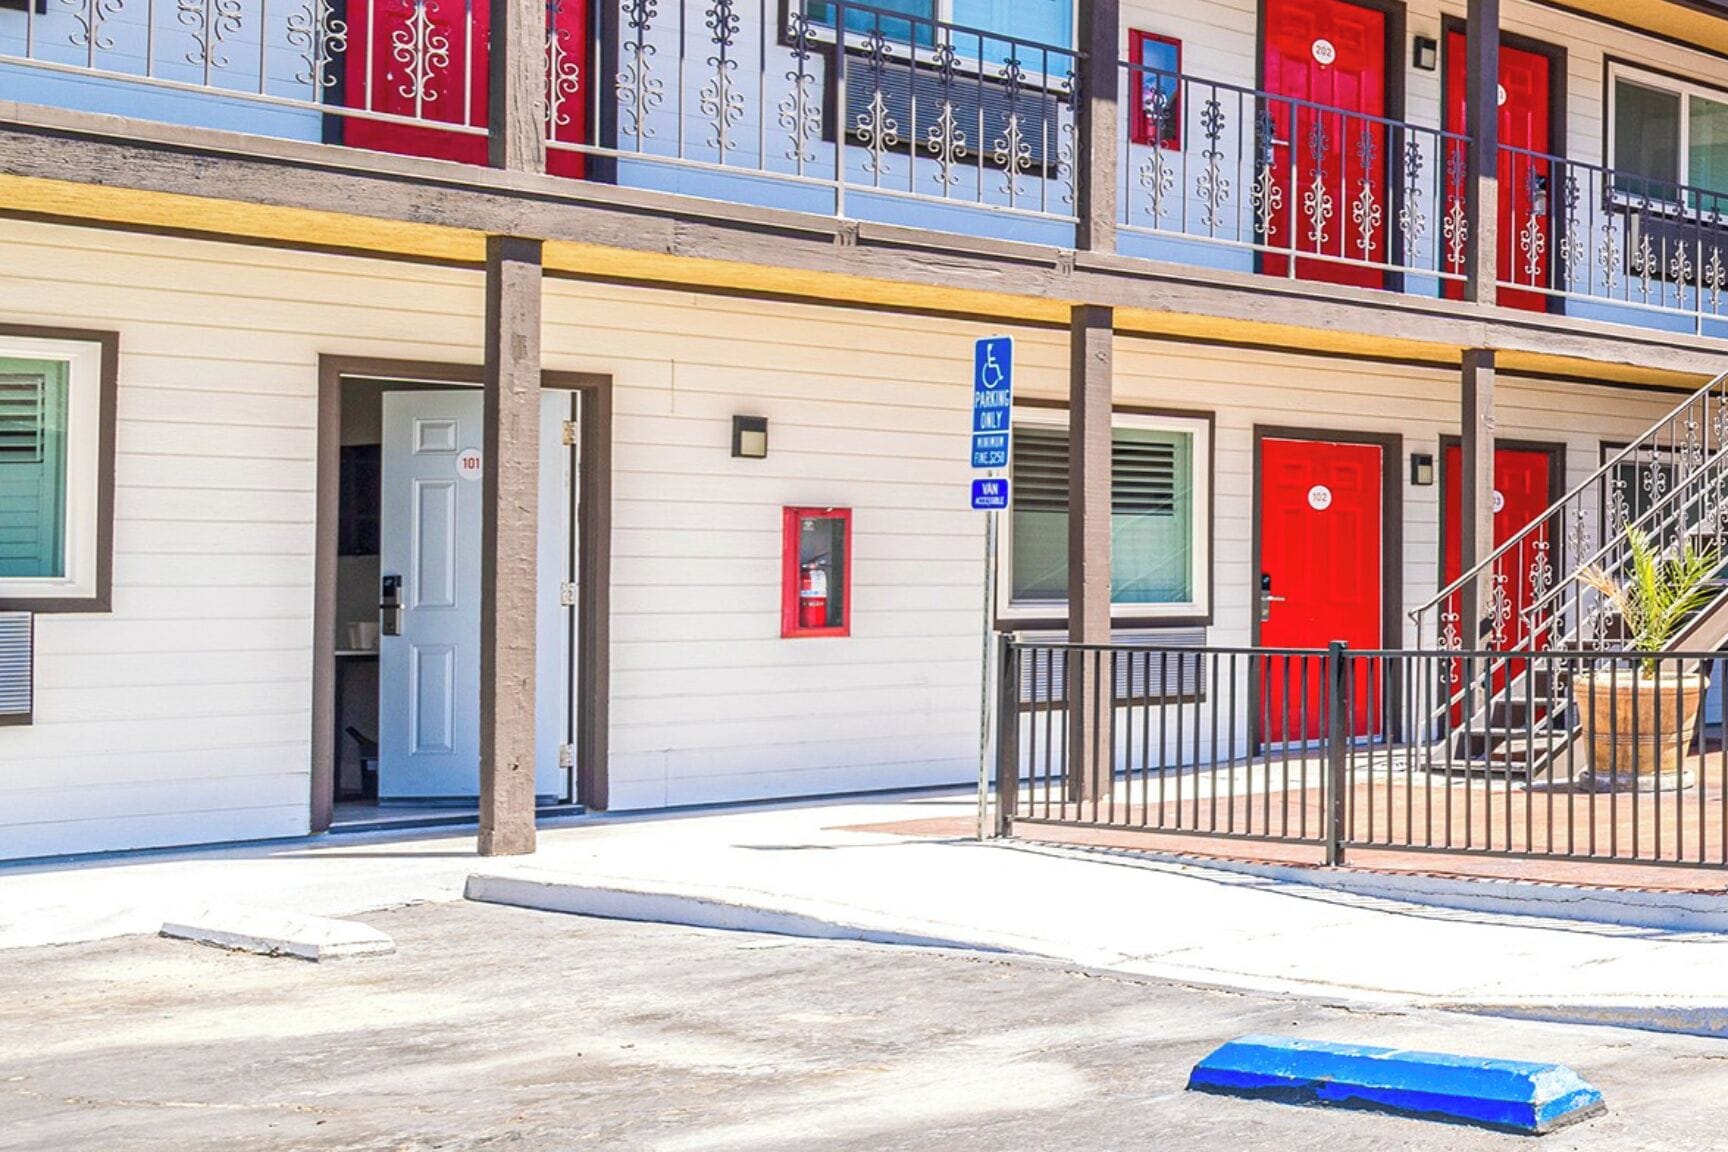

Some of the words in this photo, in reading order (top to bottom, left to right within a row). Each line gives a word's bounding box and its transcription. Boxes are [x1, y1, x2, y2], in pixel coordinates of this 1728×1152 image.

[975, 390, 1009, 408] PARKING
[980, 411, 1003, 429] ONLY
[463, 457, 480, 469] 101
[982, 483, 998, 495] VAN
